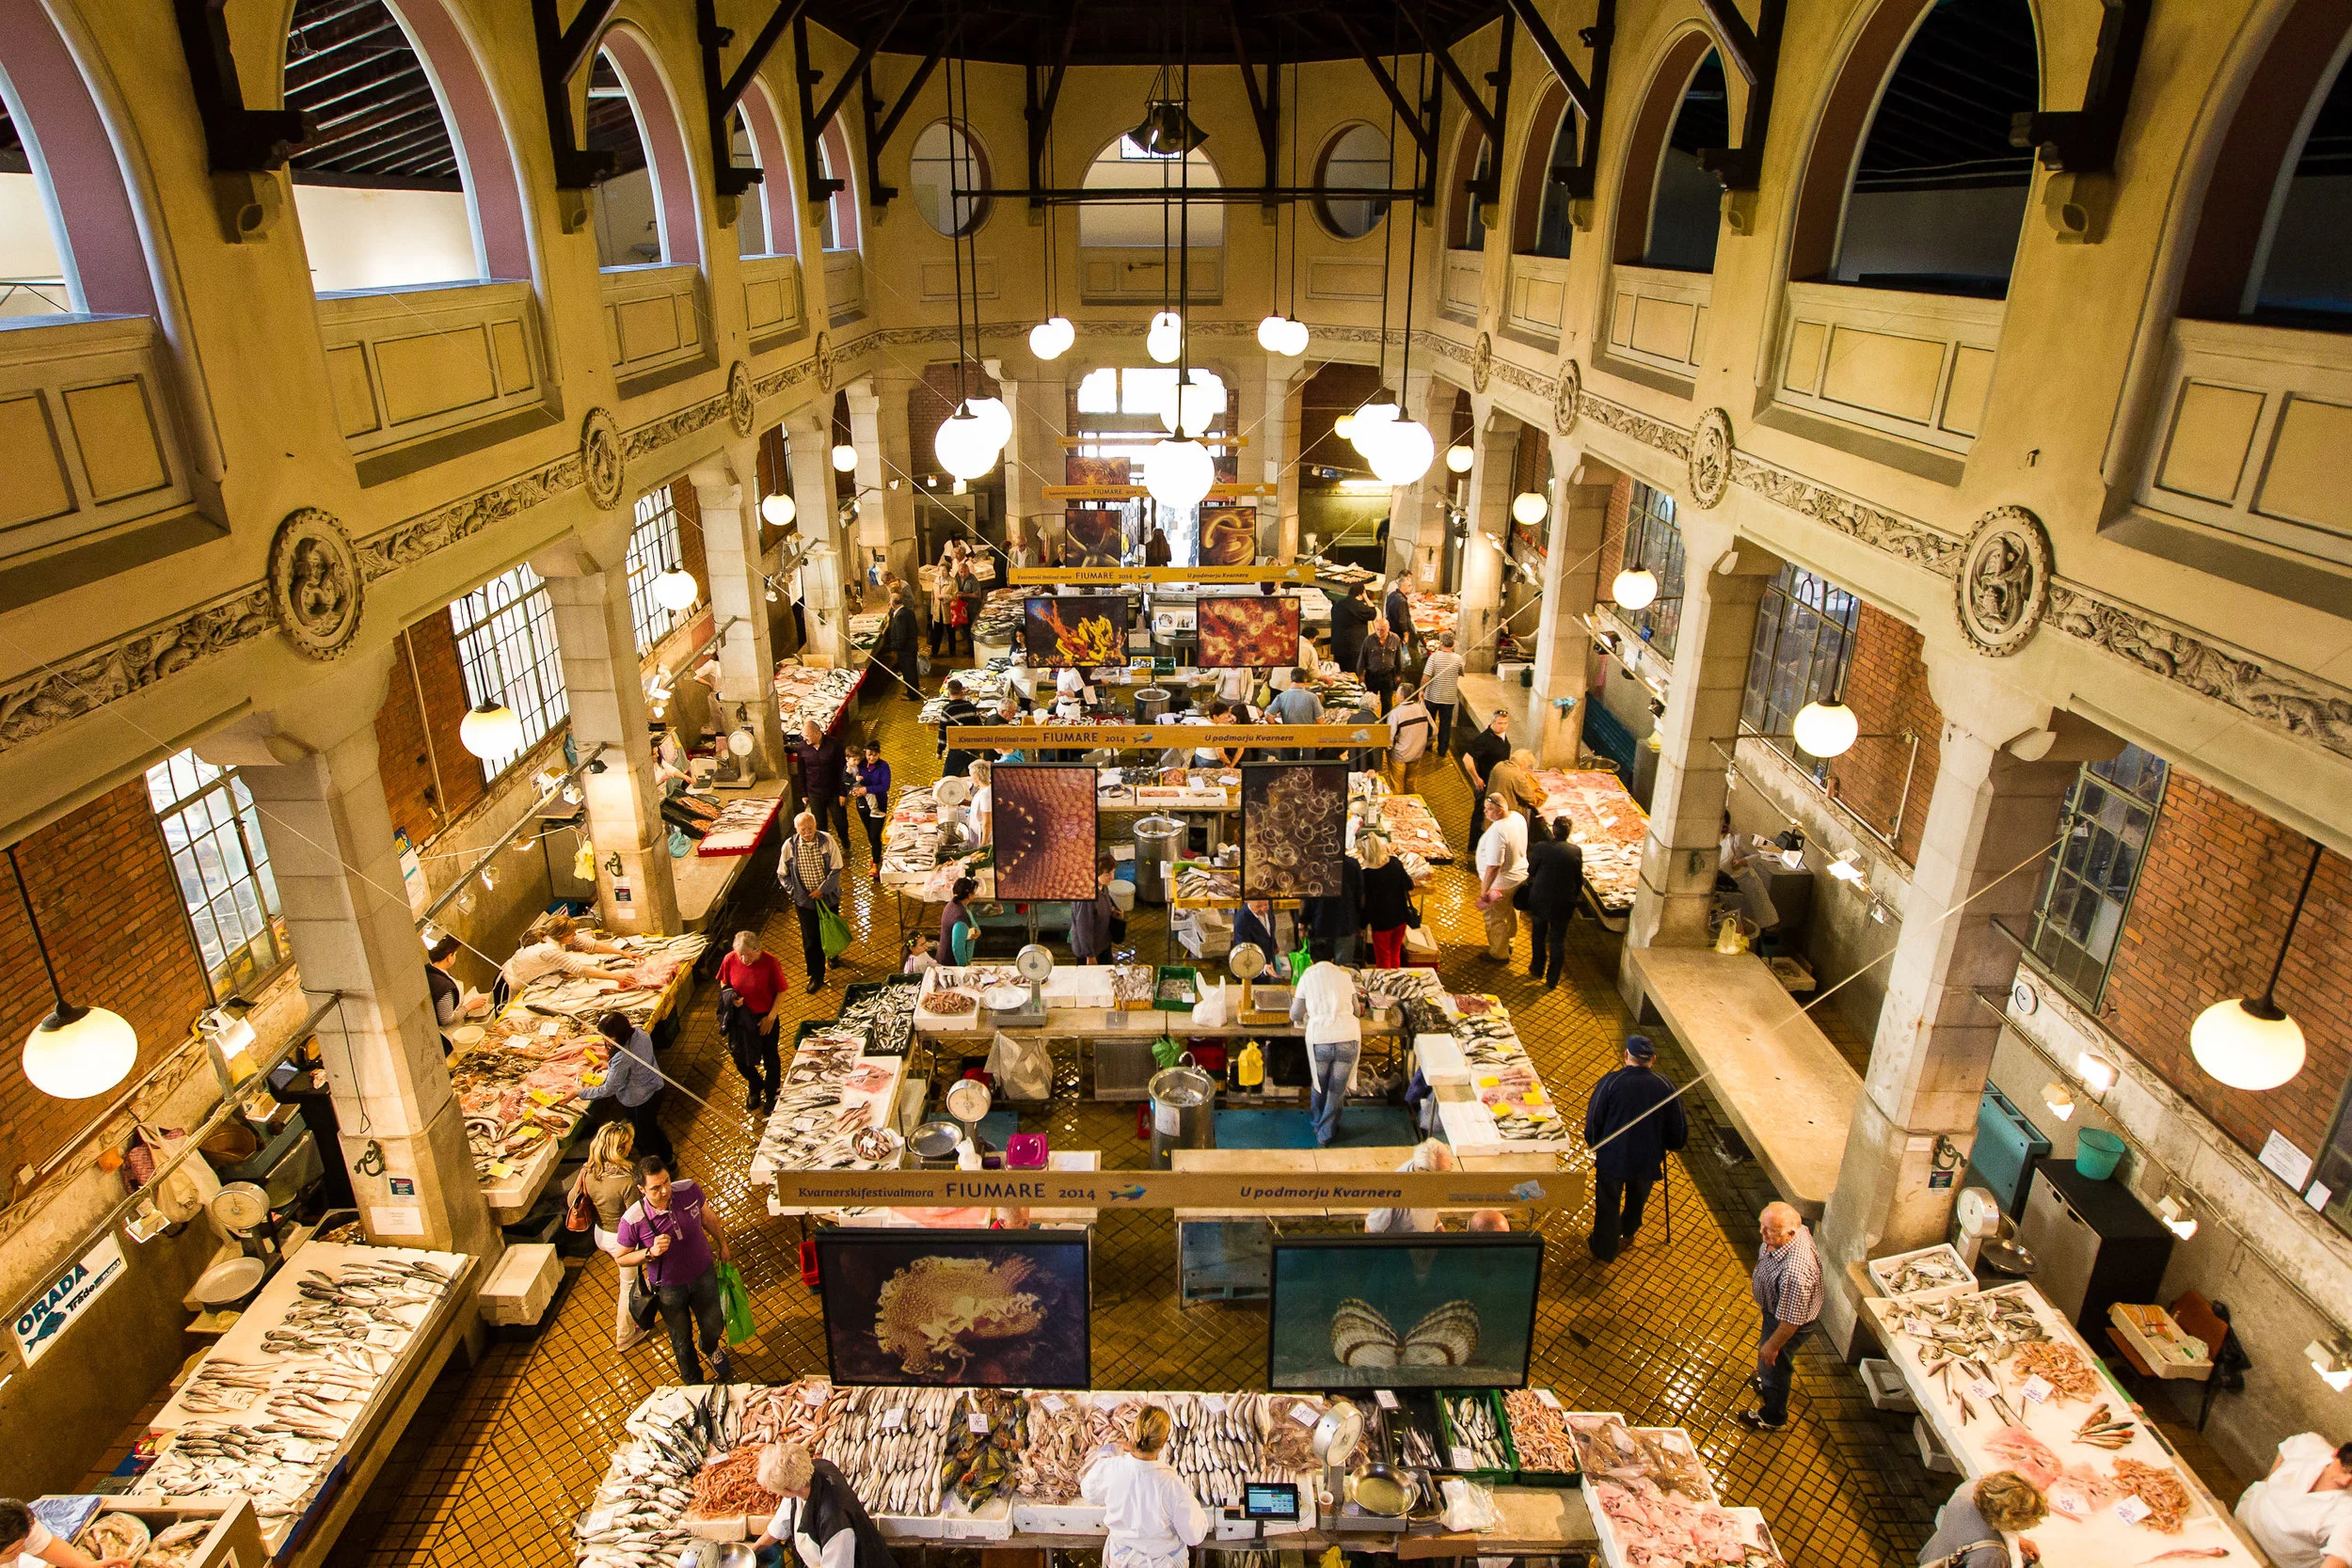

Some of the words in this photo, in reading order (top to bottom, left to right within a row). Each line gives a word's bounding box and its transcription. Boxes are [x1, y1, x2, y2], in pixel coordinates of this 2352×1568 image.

[1075, 572, 1114, 580] FIUMARE
[1042, 732, 1099, 743] FIUMARE
[1104, 736, 1126, 744] 2014
[1204, 734, 1212, 742] U
[1212, 734, 1254, 744] podmorju
[946, 1182, 1046, 1198] FIUMARE
[1057, 1188, 1096, 1201] 2014
[1240, 1186, 1252, 1197] U
[1253, 1185, 1330, 1200] podmorju
[1332, 1187, 1403, 1198] Kvarnera
[17, 1262, 90, 1336] ORADA
[65, 1282, 96, 1312] Trade
